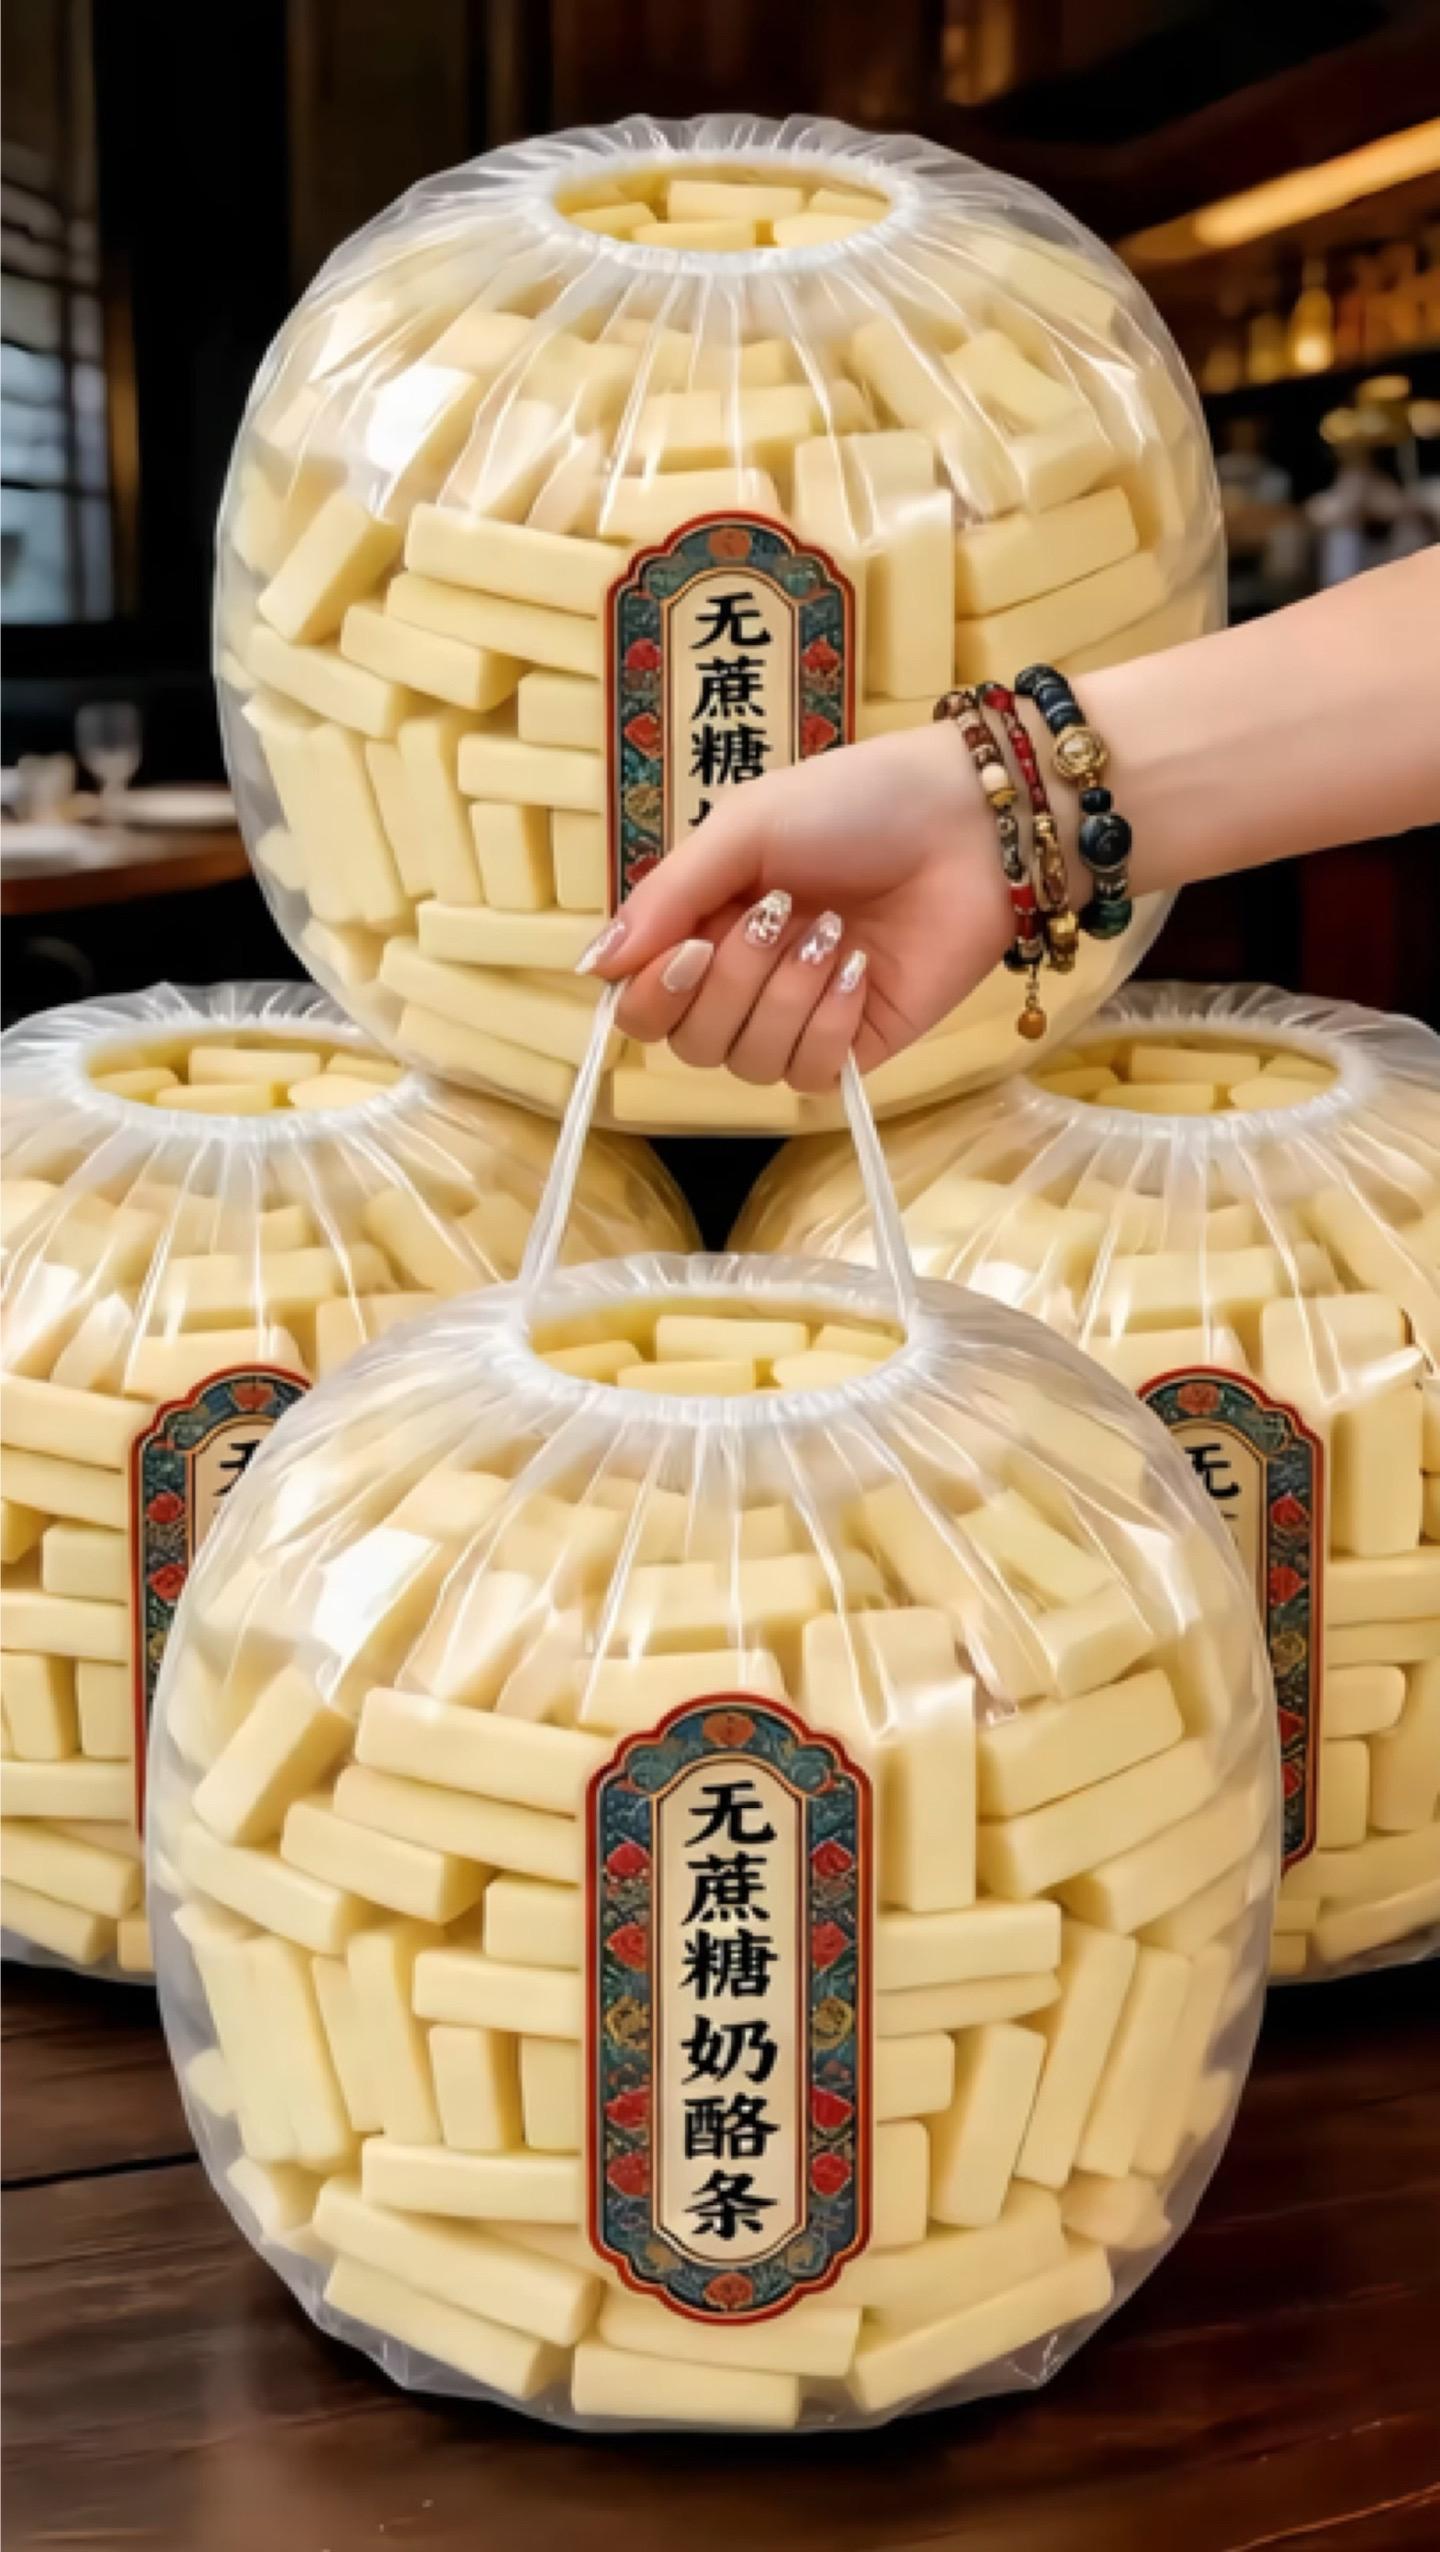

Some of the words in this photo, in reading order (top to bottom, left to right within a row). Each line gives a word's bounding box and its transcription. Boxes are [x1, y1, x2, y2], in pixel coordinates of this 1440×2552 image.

[689, 591, 772, 826] 无蔗糖
[680, 1780, 779, 2240] 无蔗糖奶酪条
